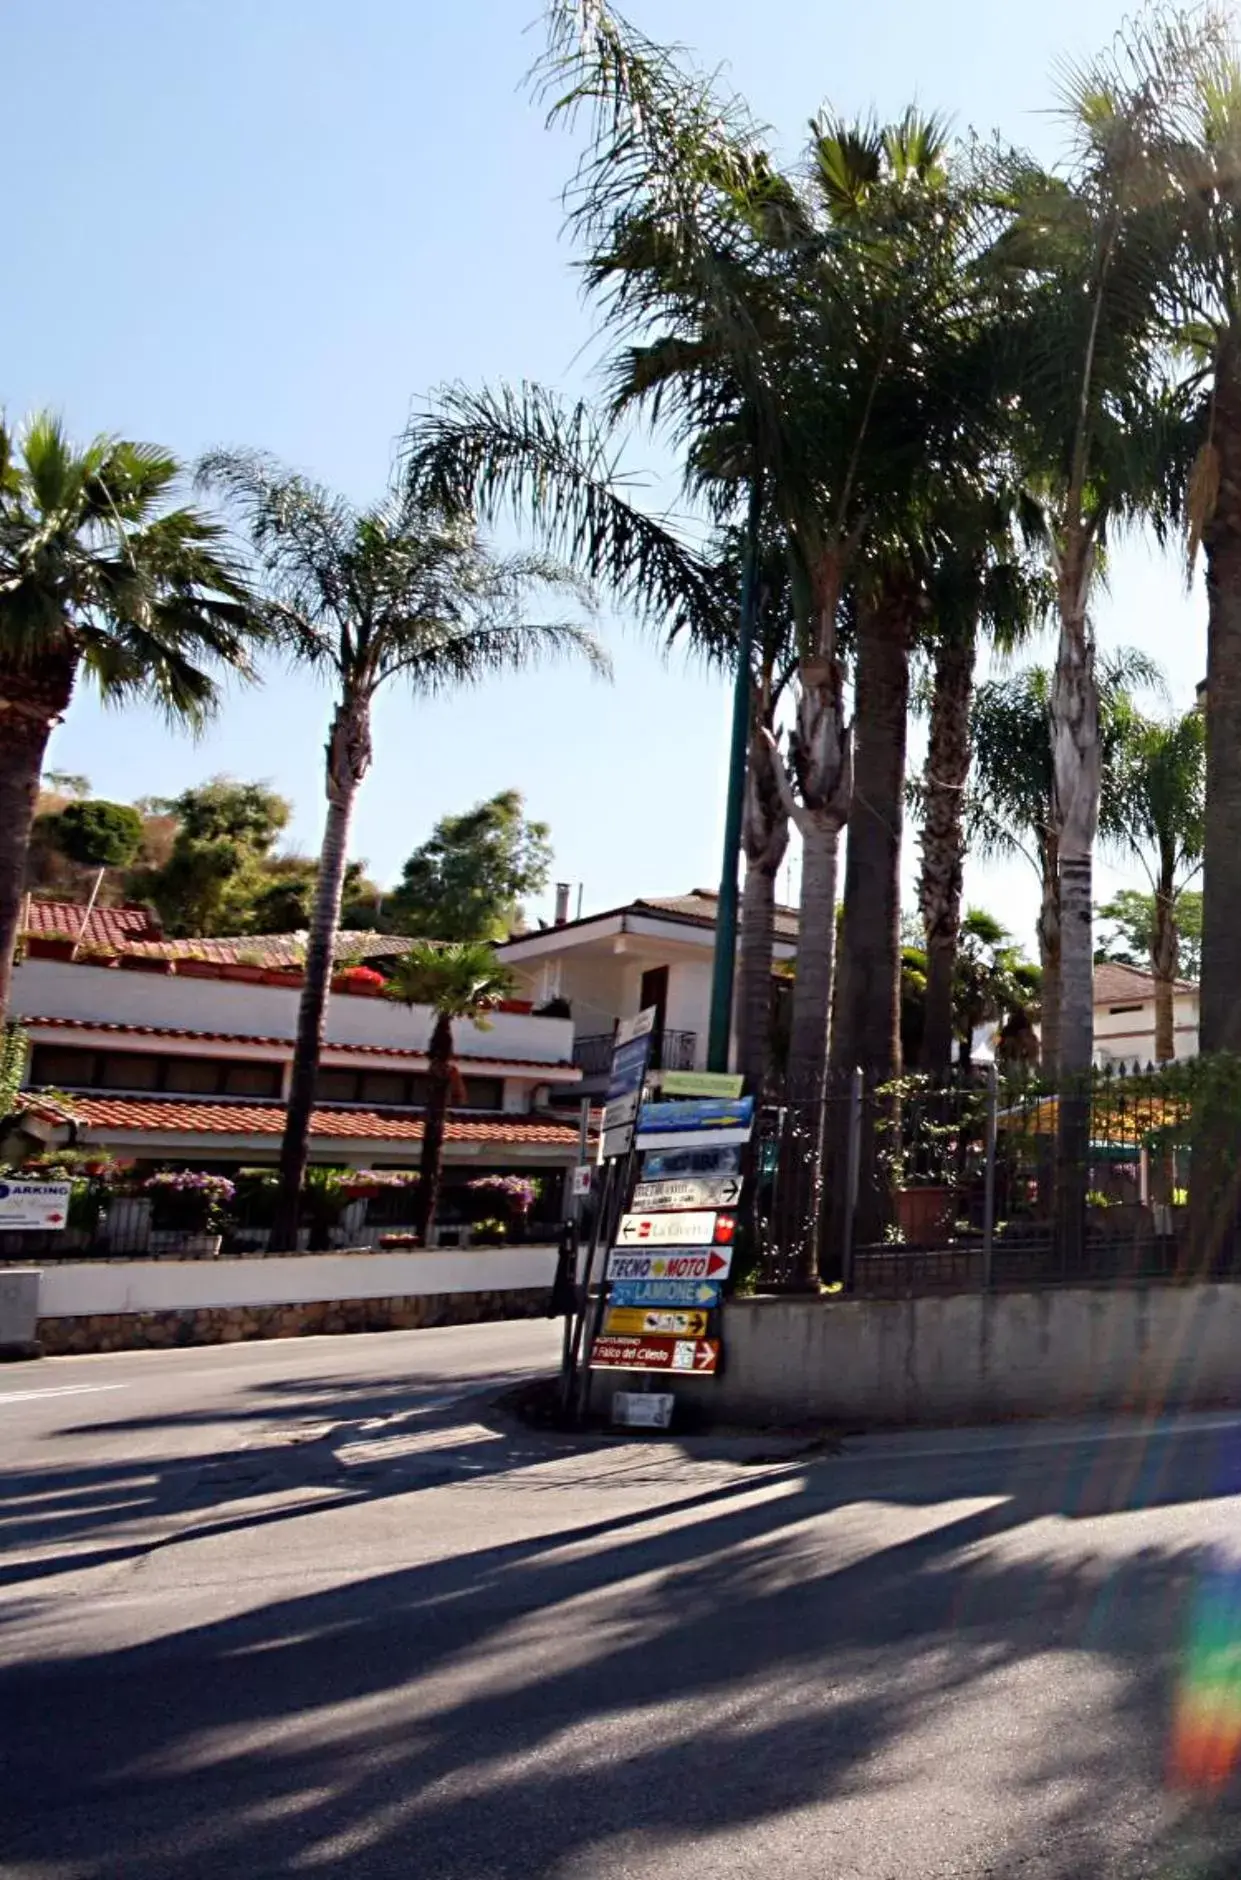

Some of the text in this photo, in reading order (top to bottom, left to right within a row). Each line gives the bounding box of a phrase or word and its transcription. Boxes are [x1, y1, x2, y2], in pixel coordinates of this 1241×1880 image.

[609, 1258, 706, 1277] TECNO MOTO
[622, 1348, 637, 1359] del
